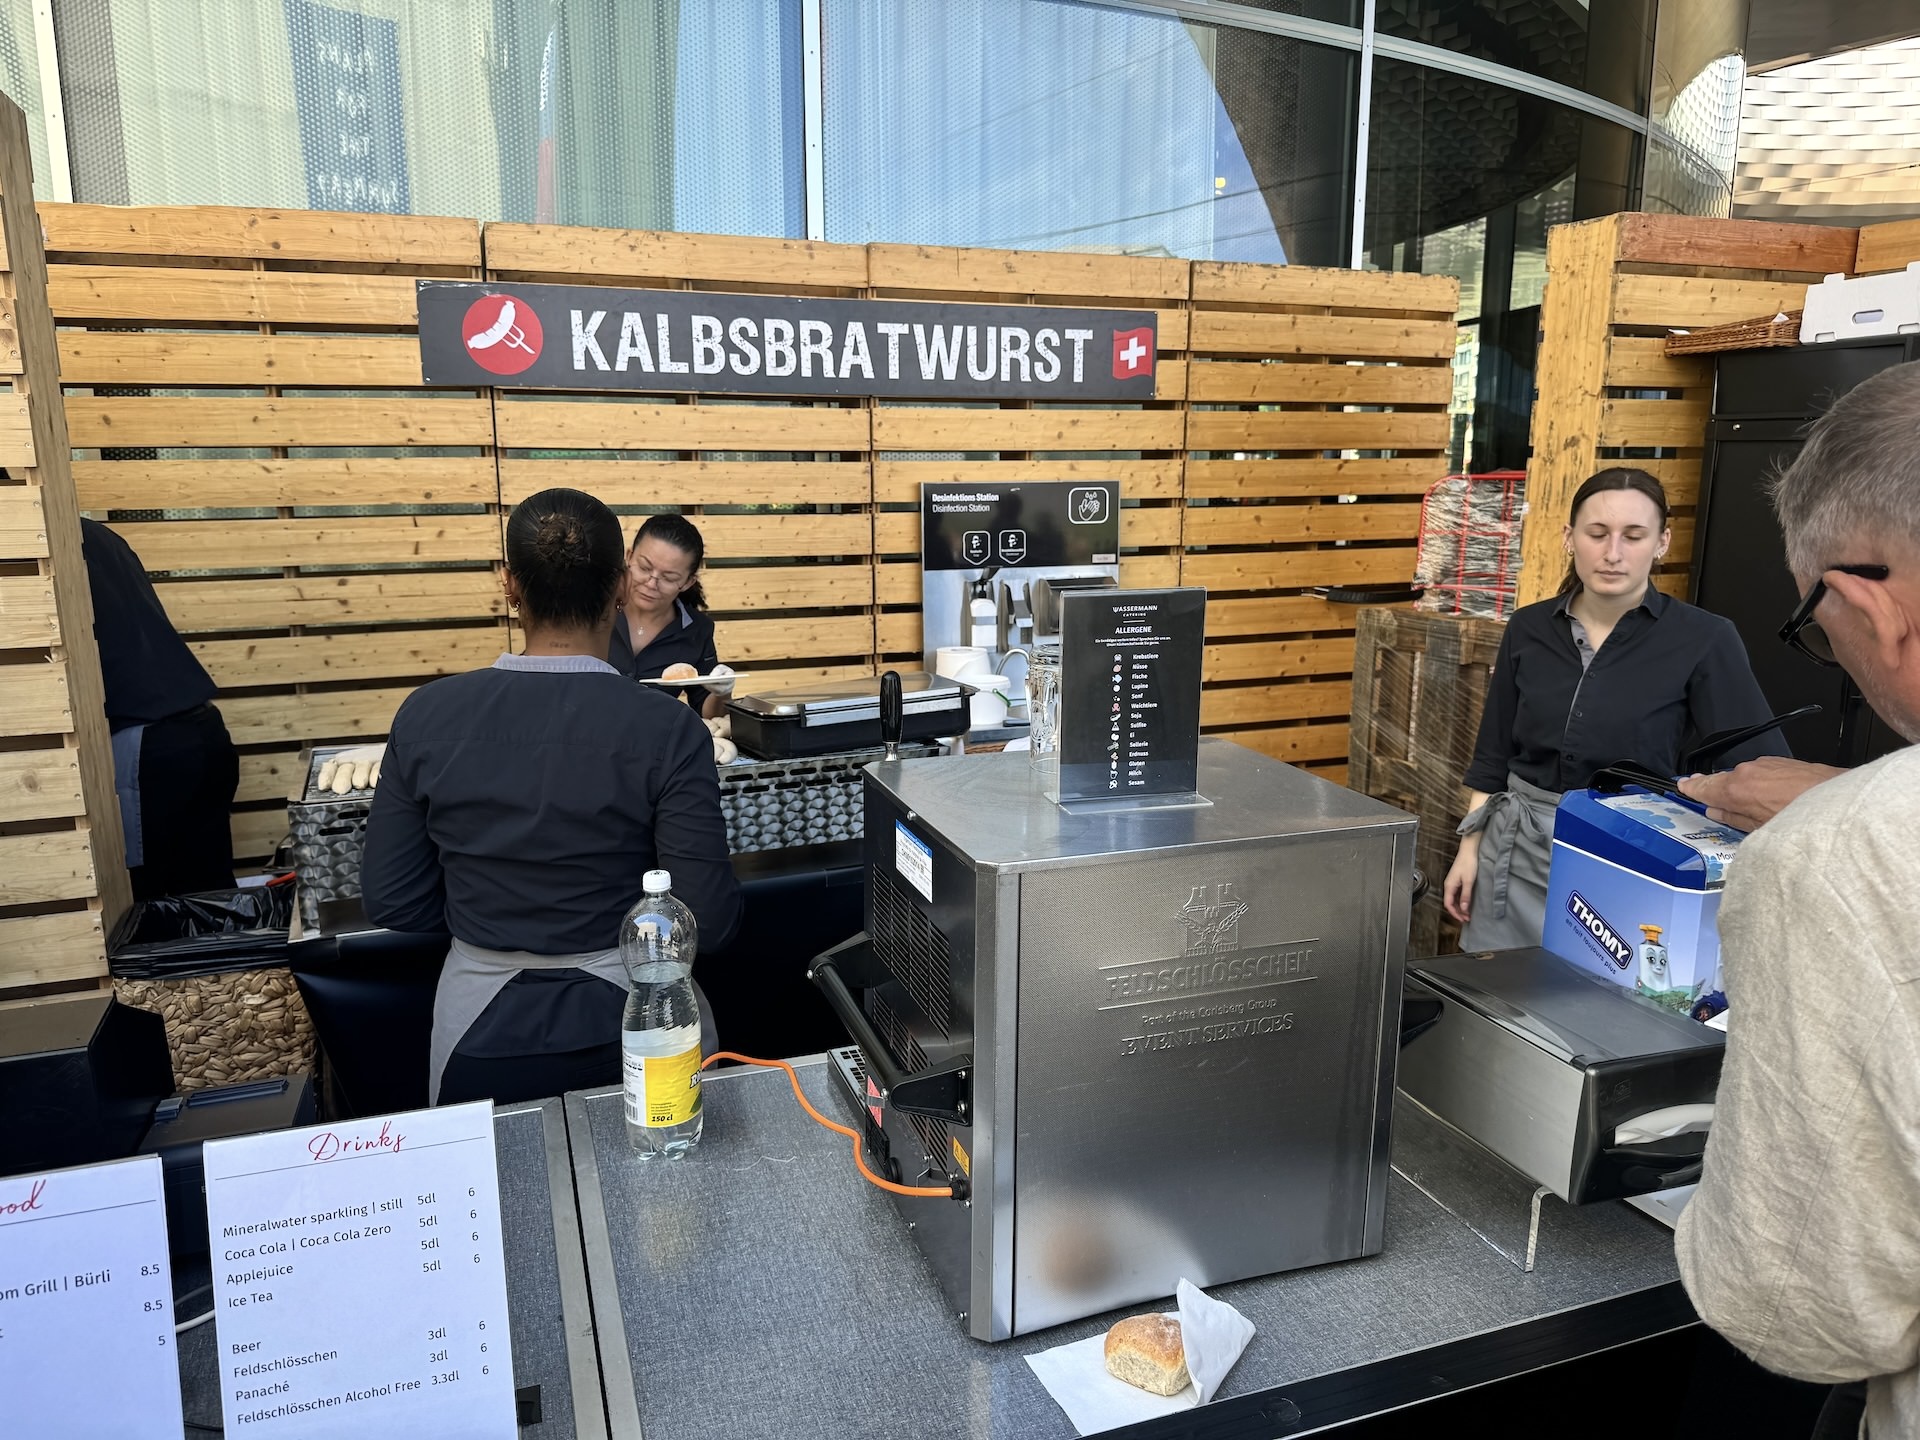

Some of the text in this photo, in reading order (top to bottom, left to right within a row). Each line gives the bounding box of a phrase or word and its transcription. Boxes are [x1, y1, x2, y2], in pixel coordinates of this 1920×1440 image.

[570, 309, 1093, 384] KALBSBRATWURST
[932, 503, 990, 513] Disinfection Station
[976, 492, 999, 501] Station
[1113, 605, 1157, 613] WASSERMANN
[1115, 626, 1153, 634] ALLERGENE
[1572, 895, 1630, 961] THOMY
[1106, 949, 1313, 1000] FELDSCHLÖSSCHEN
[1604, 961, 1617, 975] plus
[1142, 998, 1278, 1025] Part of the Carlsberg Group
[1121, 1012, 1294, 1056] EVENT SERVICES
[307, 1120, 407, 1161] Drinks
[223, 1215, 307, 1238] Mineralwater
[310, 1205, 368, 1225] sparkling
[380, 1198, 403, 1212] still
[417, 1192, 436, 1205] 5dl
[468, 1187, 475, 1197] 6
[225, 1248, 255, 1261] Coca
[259, 1242, 287, 1255] Cola
[300, 1235, 329, 1248] Coca
[333, 1229, 360, 1242] Cola
[364, 1225, 392, 1237] Zero
[419, 1215, 438, 1228] 5dl
[470, 1209, 477, 1219] 6
[226, 1231, 479, 1286] Applejuice 5dl 6
[25, 1277, 58, 1297] Grill
[75, 1269, 111, 1288] Bürli
[141, 1263, 160, 1276] 8.5
[228, 1254, 480, 1308] Ice Tea 5dl 6
[144, 1299, 163, 1313] 8.5
[158, 1335, 166, 1346] 5
[232, 1341, 261, 1354] Beer
[234, 1320, 486, 1378] Feldschlösschen 3dl 6
[235, 1342, 487, 1401] Panaché 3dl 6
[237, 1365, 489, 1424] Feldschlösschen Alcohol Free 3.3dl 6
